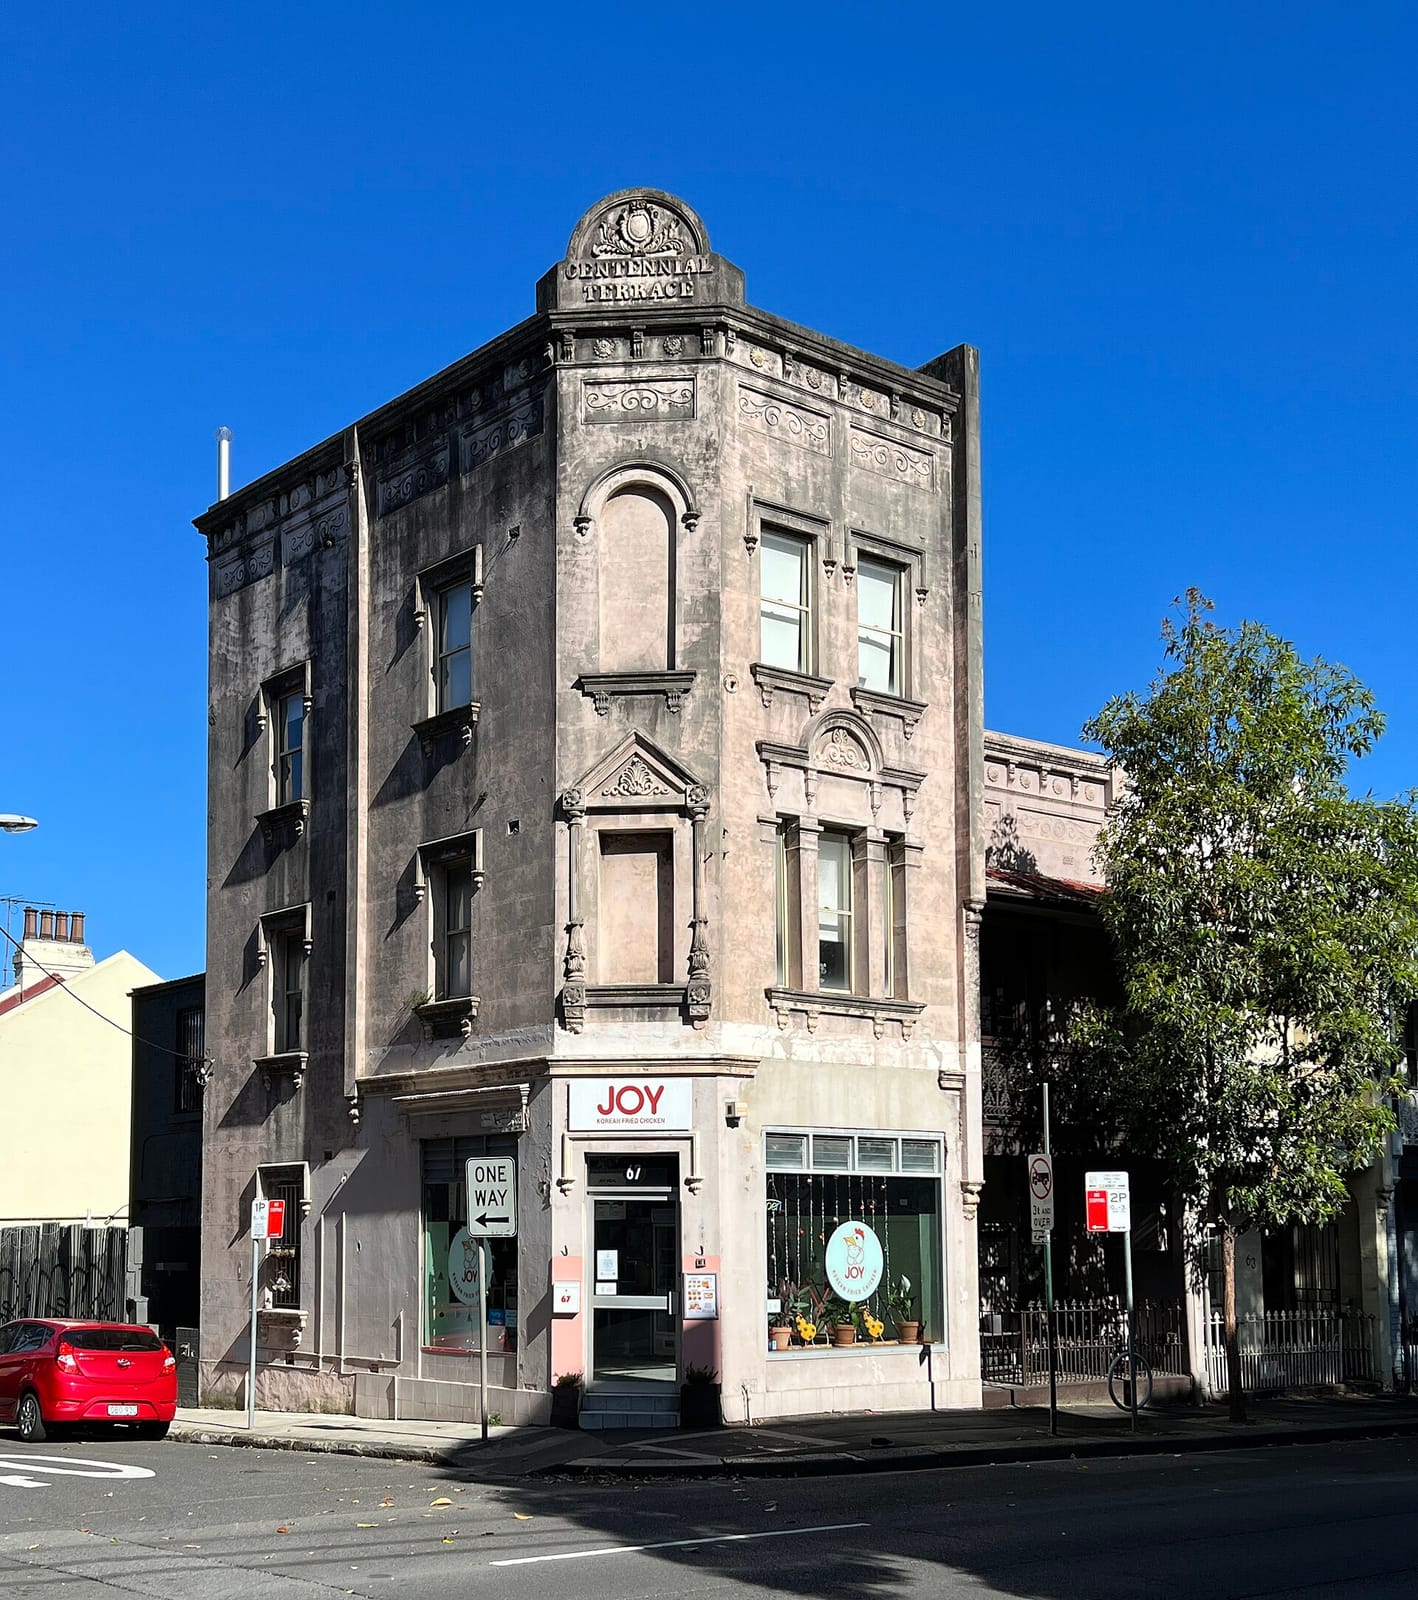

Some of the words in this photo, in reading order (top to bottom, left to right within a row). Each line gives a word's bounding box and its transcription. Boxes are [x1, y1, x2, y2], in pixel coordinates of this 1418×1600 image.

[565, 257, 713, 279] CENTENNIAL
[583, 281, 694, 303] TERRACE
[597, 1085, 665, 1115] JOY
[596, 1117, 621, 1125] KOREAN
[475, 1165, 507, 1183] ONE
[475, 1189, 508, 1207] WAY
[1110, 1192, 1127, 1203] 2P
[255, 1201, 266, 1212] 1P
[1033, 1217, 1051, 1226] OVER
[462, 1269, 478, 1283] JOY
[845, 1266, 865, 1279] JOY
[561, 1295, 571, 1303] 67
